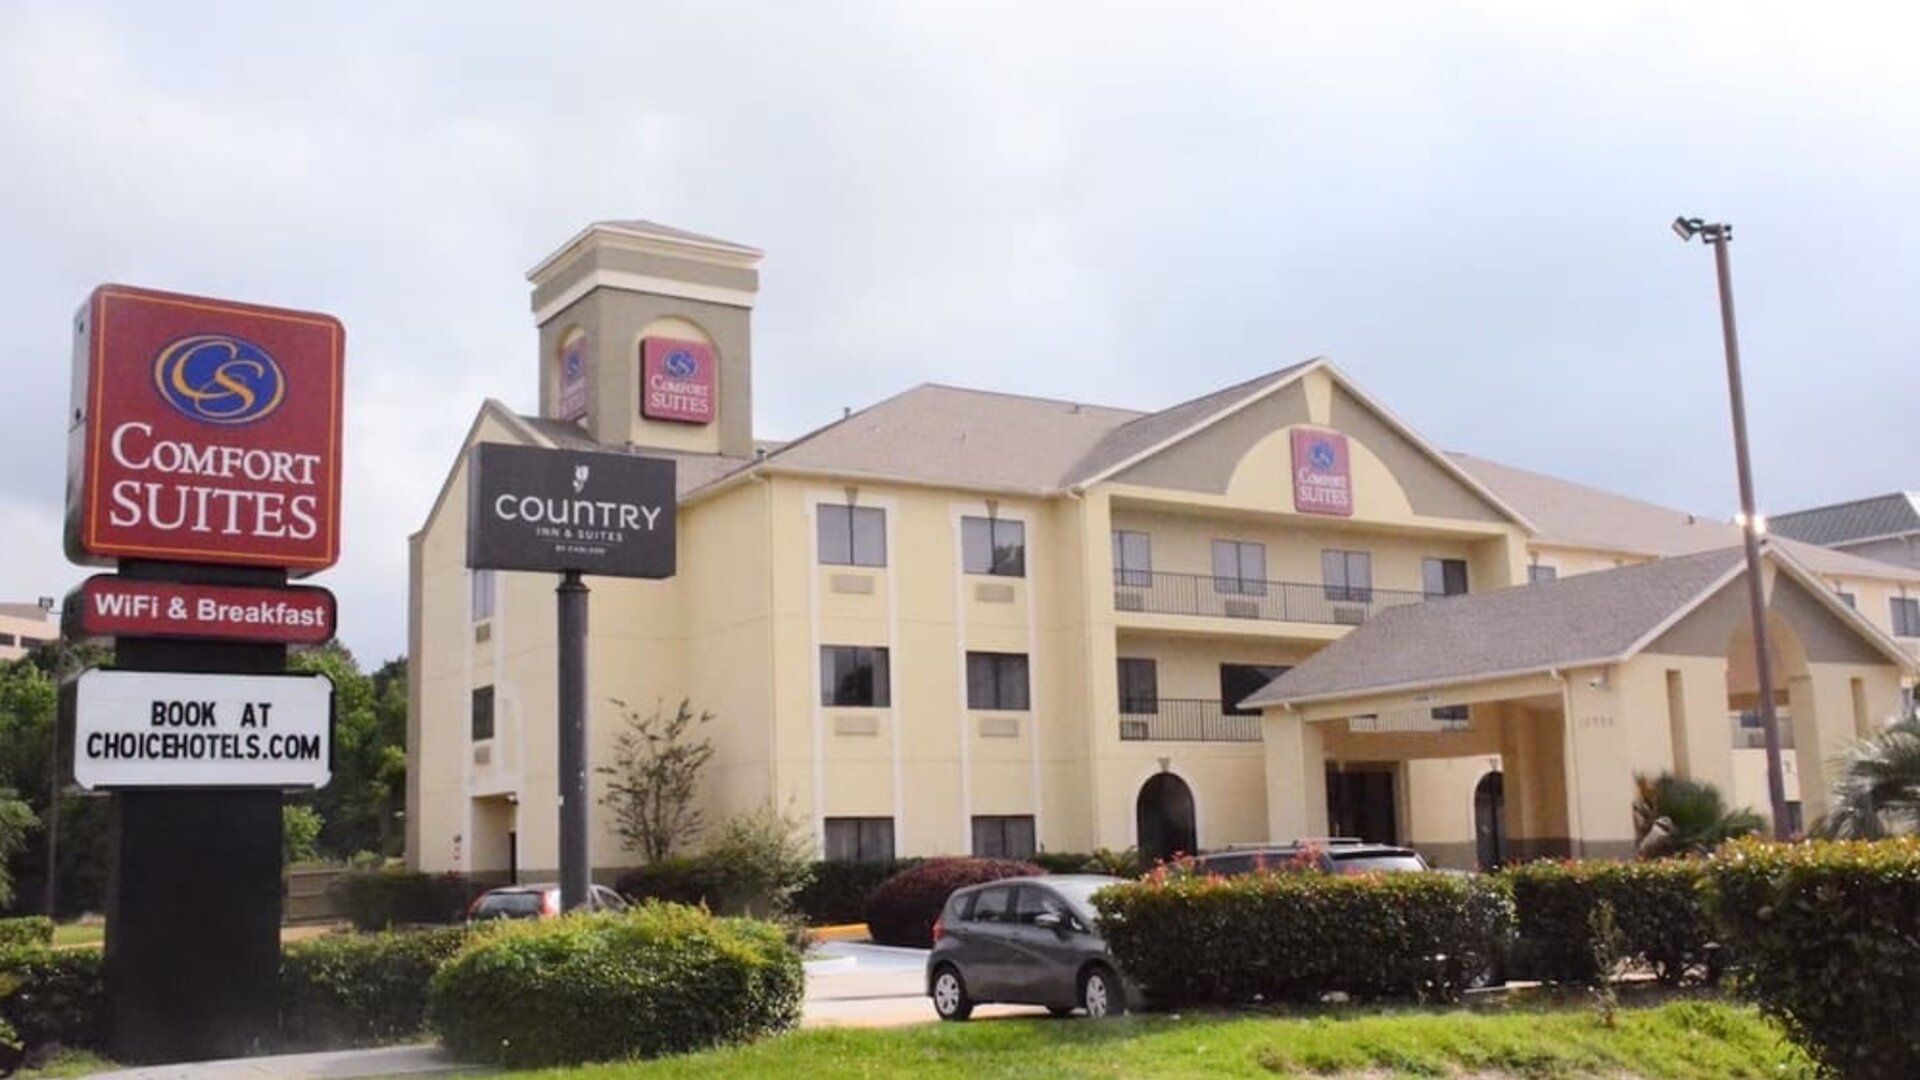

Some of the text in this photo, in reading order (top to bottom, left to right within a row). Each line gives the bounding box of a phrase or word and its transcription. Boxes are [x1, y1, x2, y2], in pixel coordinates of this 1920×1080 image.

[651, 392, 709, 413] SUITES
[111, 421, 321, 485] COMFORT
[109, 480, 318, 540] SUITES
[495, 494, 661, 530] COUNTRY
[536, 527, 560, 537] INN
[577, 529, 623, 542] SUITES
[95, 593, 325, 627] WiFi & Breakfast
[151, 701, 272, 727] BOOK AT
[86, 732, 320, 760] CHOICEHOTELS.COM
